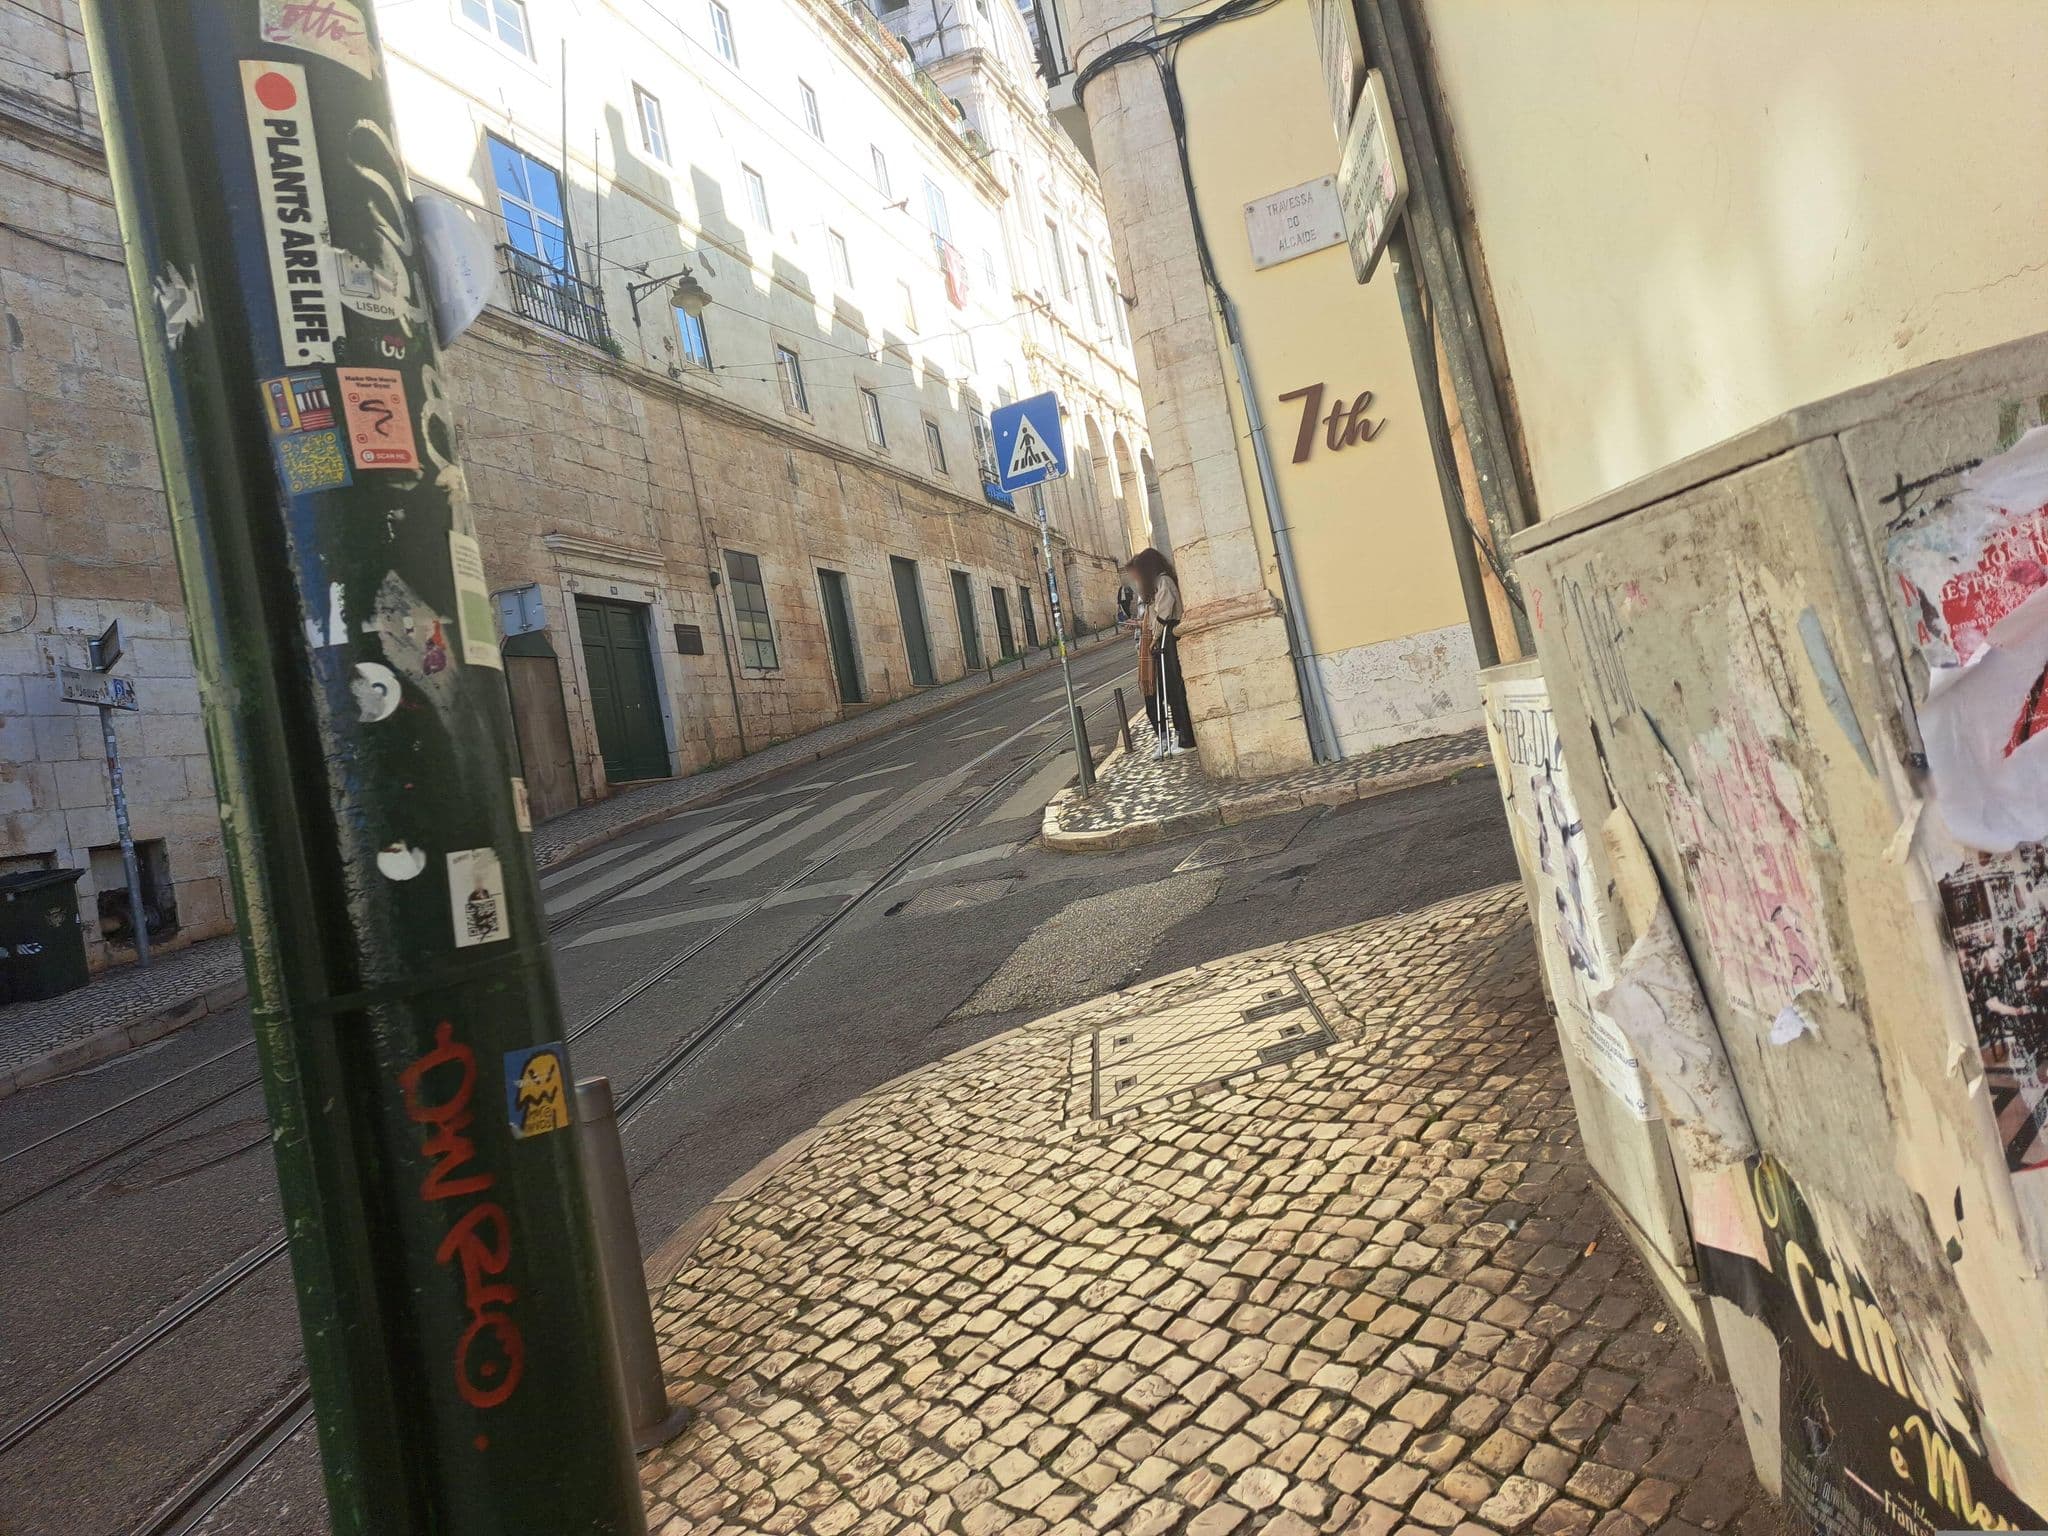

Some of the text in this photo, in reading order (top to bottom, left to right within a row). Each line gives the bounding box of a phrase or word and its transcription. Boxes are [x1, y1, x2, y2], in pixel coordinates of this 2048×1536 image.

[1265, 191, 1314, 217] TRAVESSA
[1286, 215, 1300, 229] DO
[263, 118, 331, 358] PLANTS ARE LIFE.
[1279, 229, 1318, 252] ALCAIDE
[355, 300, 396, 317] LISBON
[1279, 382, 1386, 464] 7th
